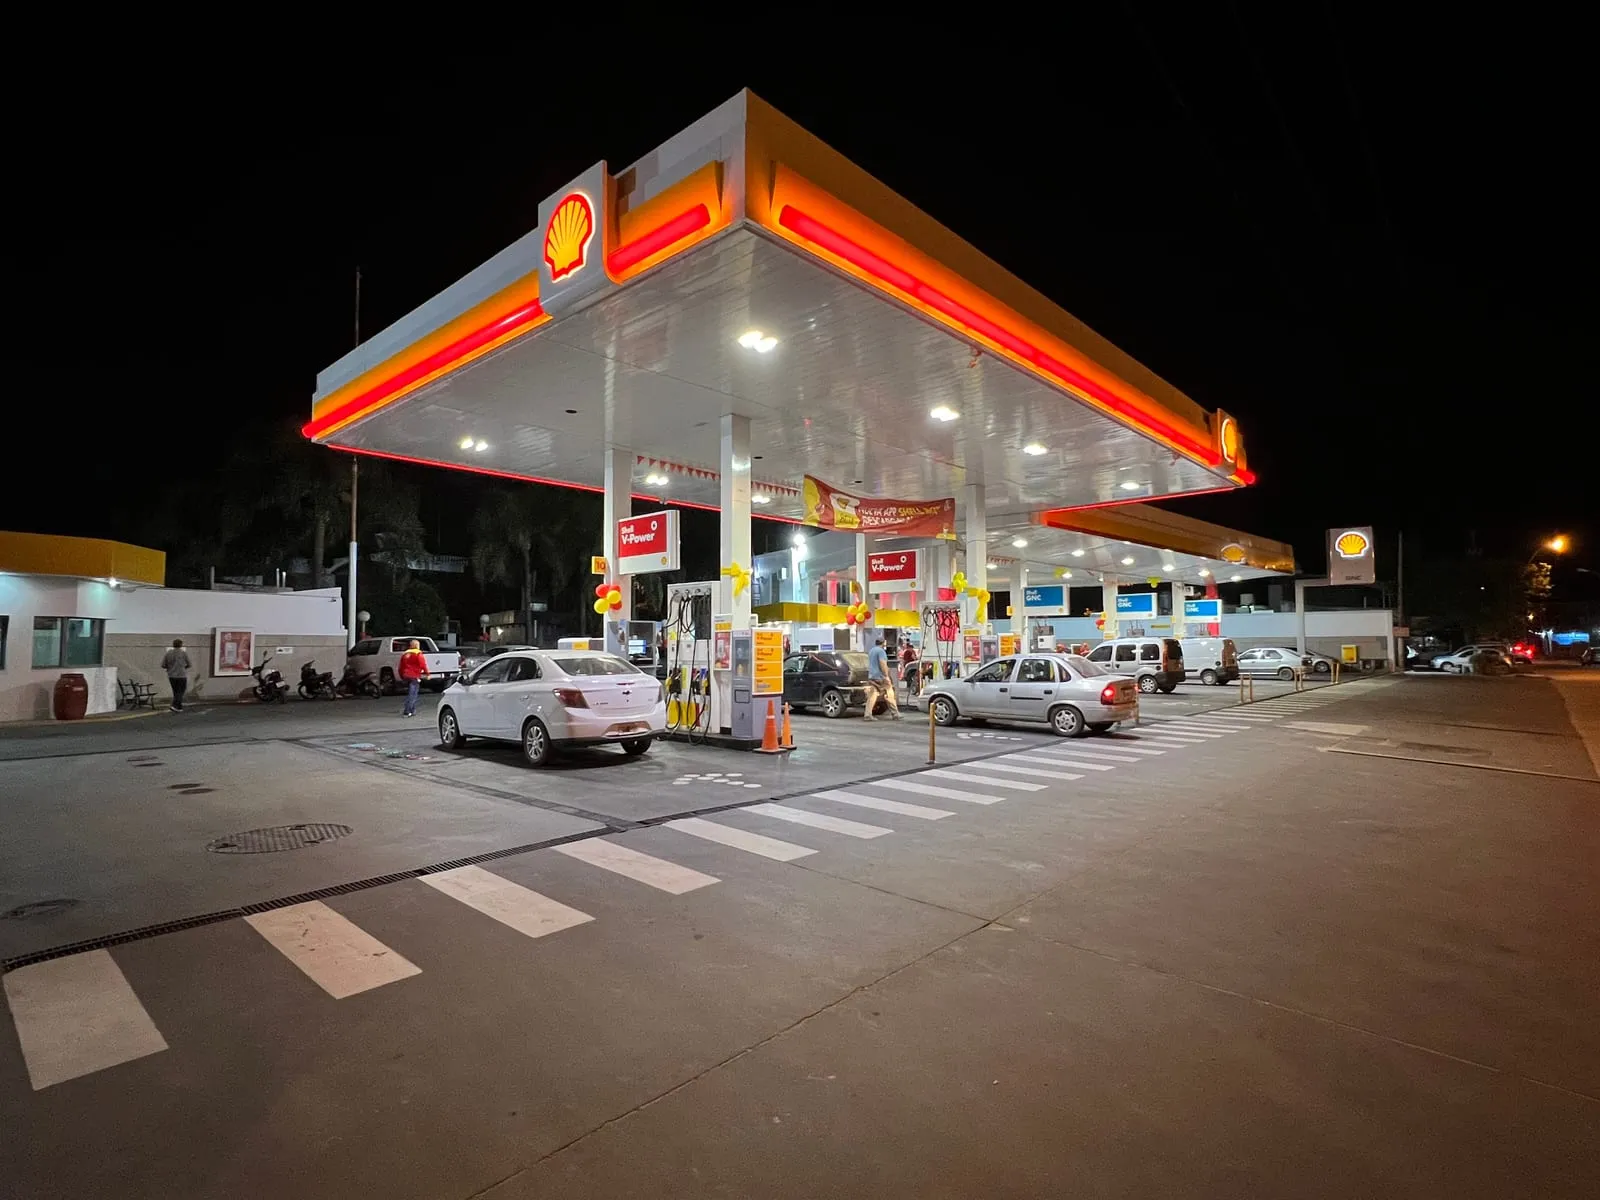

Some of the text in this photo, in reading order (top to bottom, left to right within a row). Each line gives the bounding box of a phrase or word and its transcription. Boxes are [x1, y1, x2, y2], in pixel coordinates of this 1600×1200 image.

[621, 525, 634, 534] Shell
[621, 533, 655, 545] V-Power
[596, 560, 606, 570] 10
[871, 564, 905, 572] V-Power
